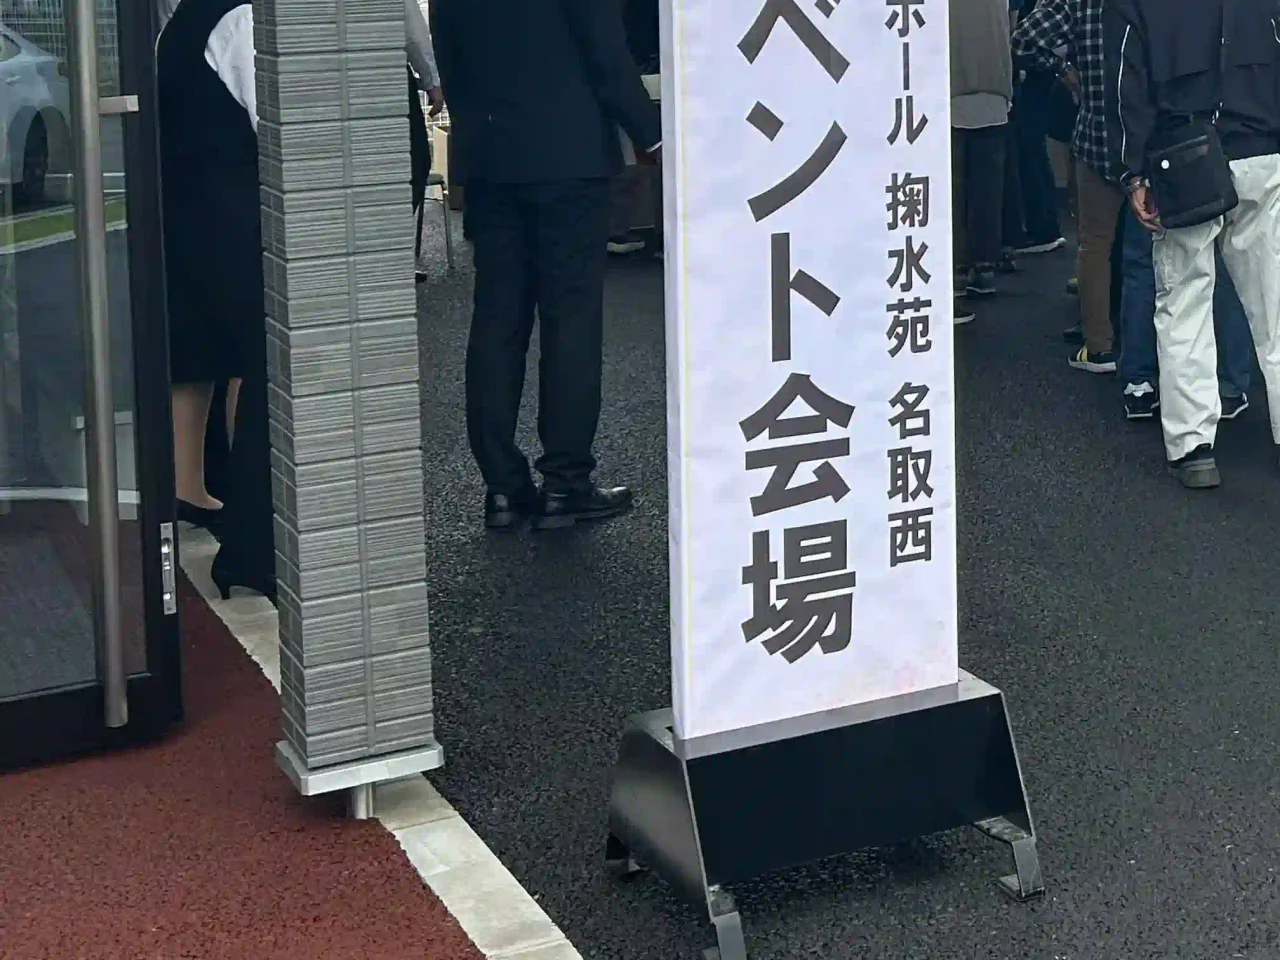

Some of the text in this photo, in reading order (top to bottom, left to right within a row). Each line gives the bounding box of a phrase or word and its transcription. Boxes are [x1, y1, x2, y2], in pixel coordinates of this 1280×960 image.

[885, 172, 931, 358] 掬水苑
[887, 382, 934, 567] 名取西
